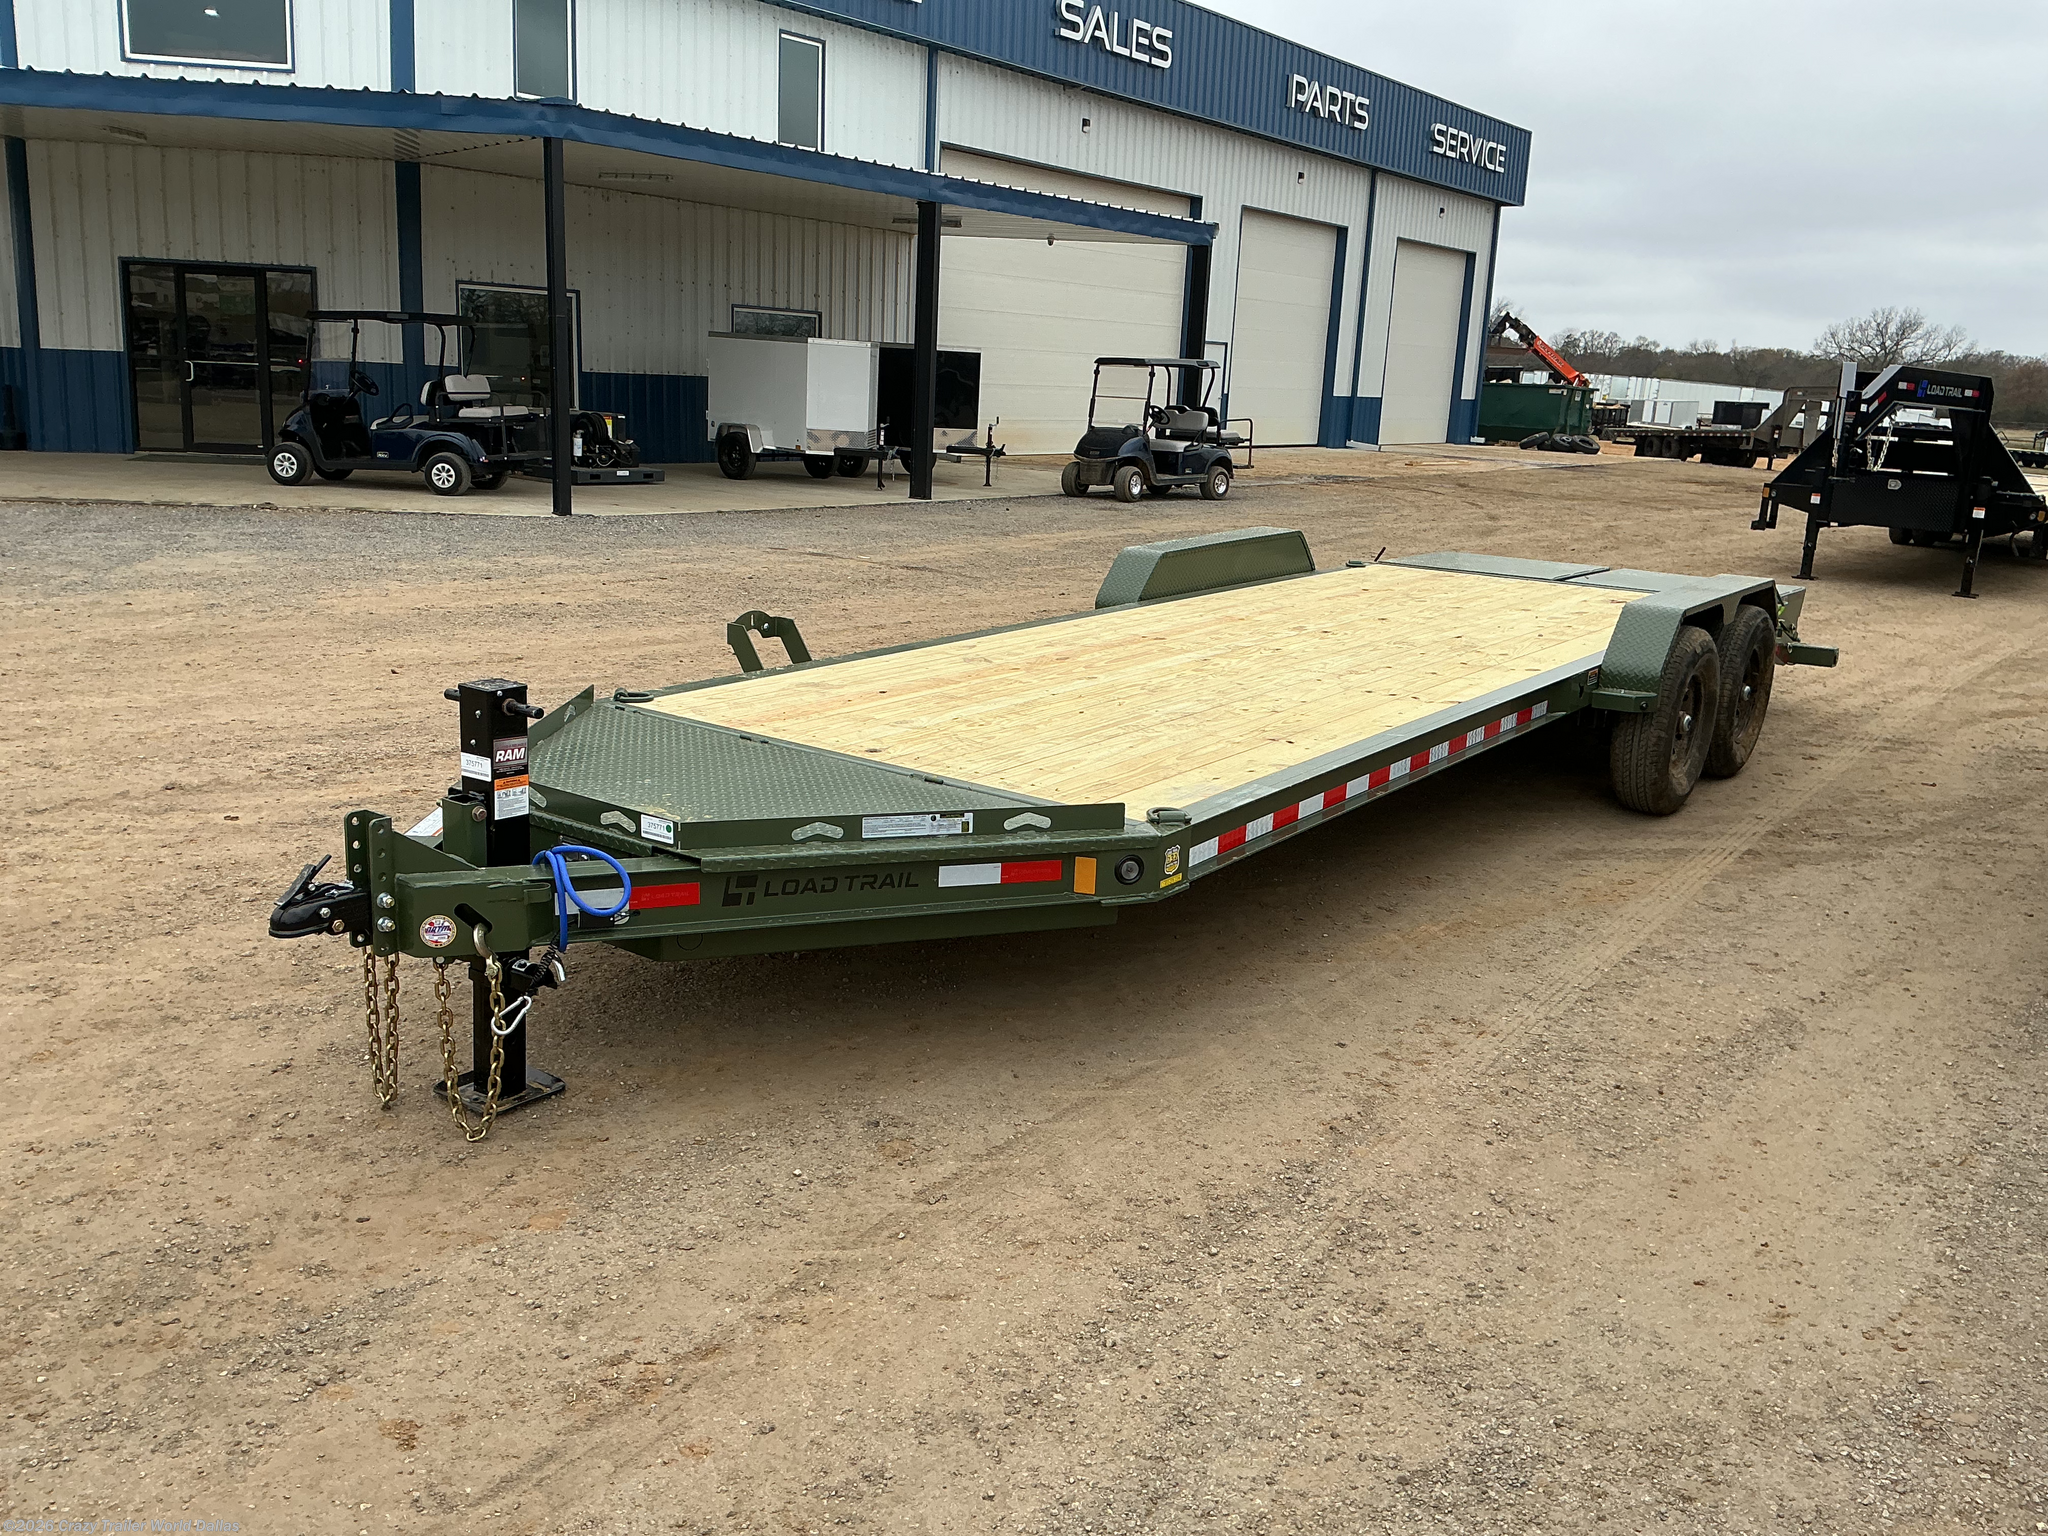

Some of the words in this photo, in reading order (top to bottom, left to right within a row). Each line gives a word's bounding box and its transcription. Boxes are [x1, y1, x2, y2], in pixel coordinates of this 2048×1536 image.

[1056, 0, 1173, 69] SALES
[1287, 73, 1370, 131] PARTS
[1431, 122, 1507, 173] SERVICE
[465, 758, 483, 769] 375771
[495, 747, 526, 763] RAM
[647, 821, 665, 831] 375771
[763, 876, 839, 898] LOAD
[844, 872, 919, 892] TRAIL
